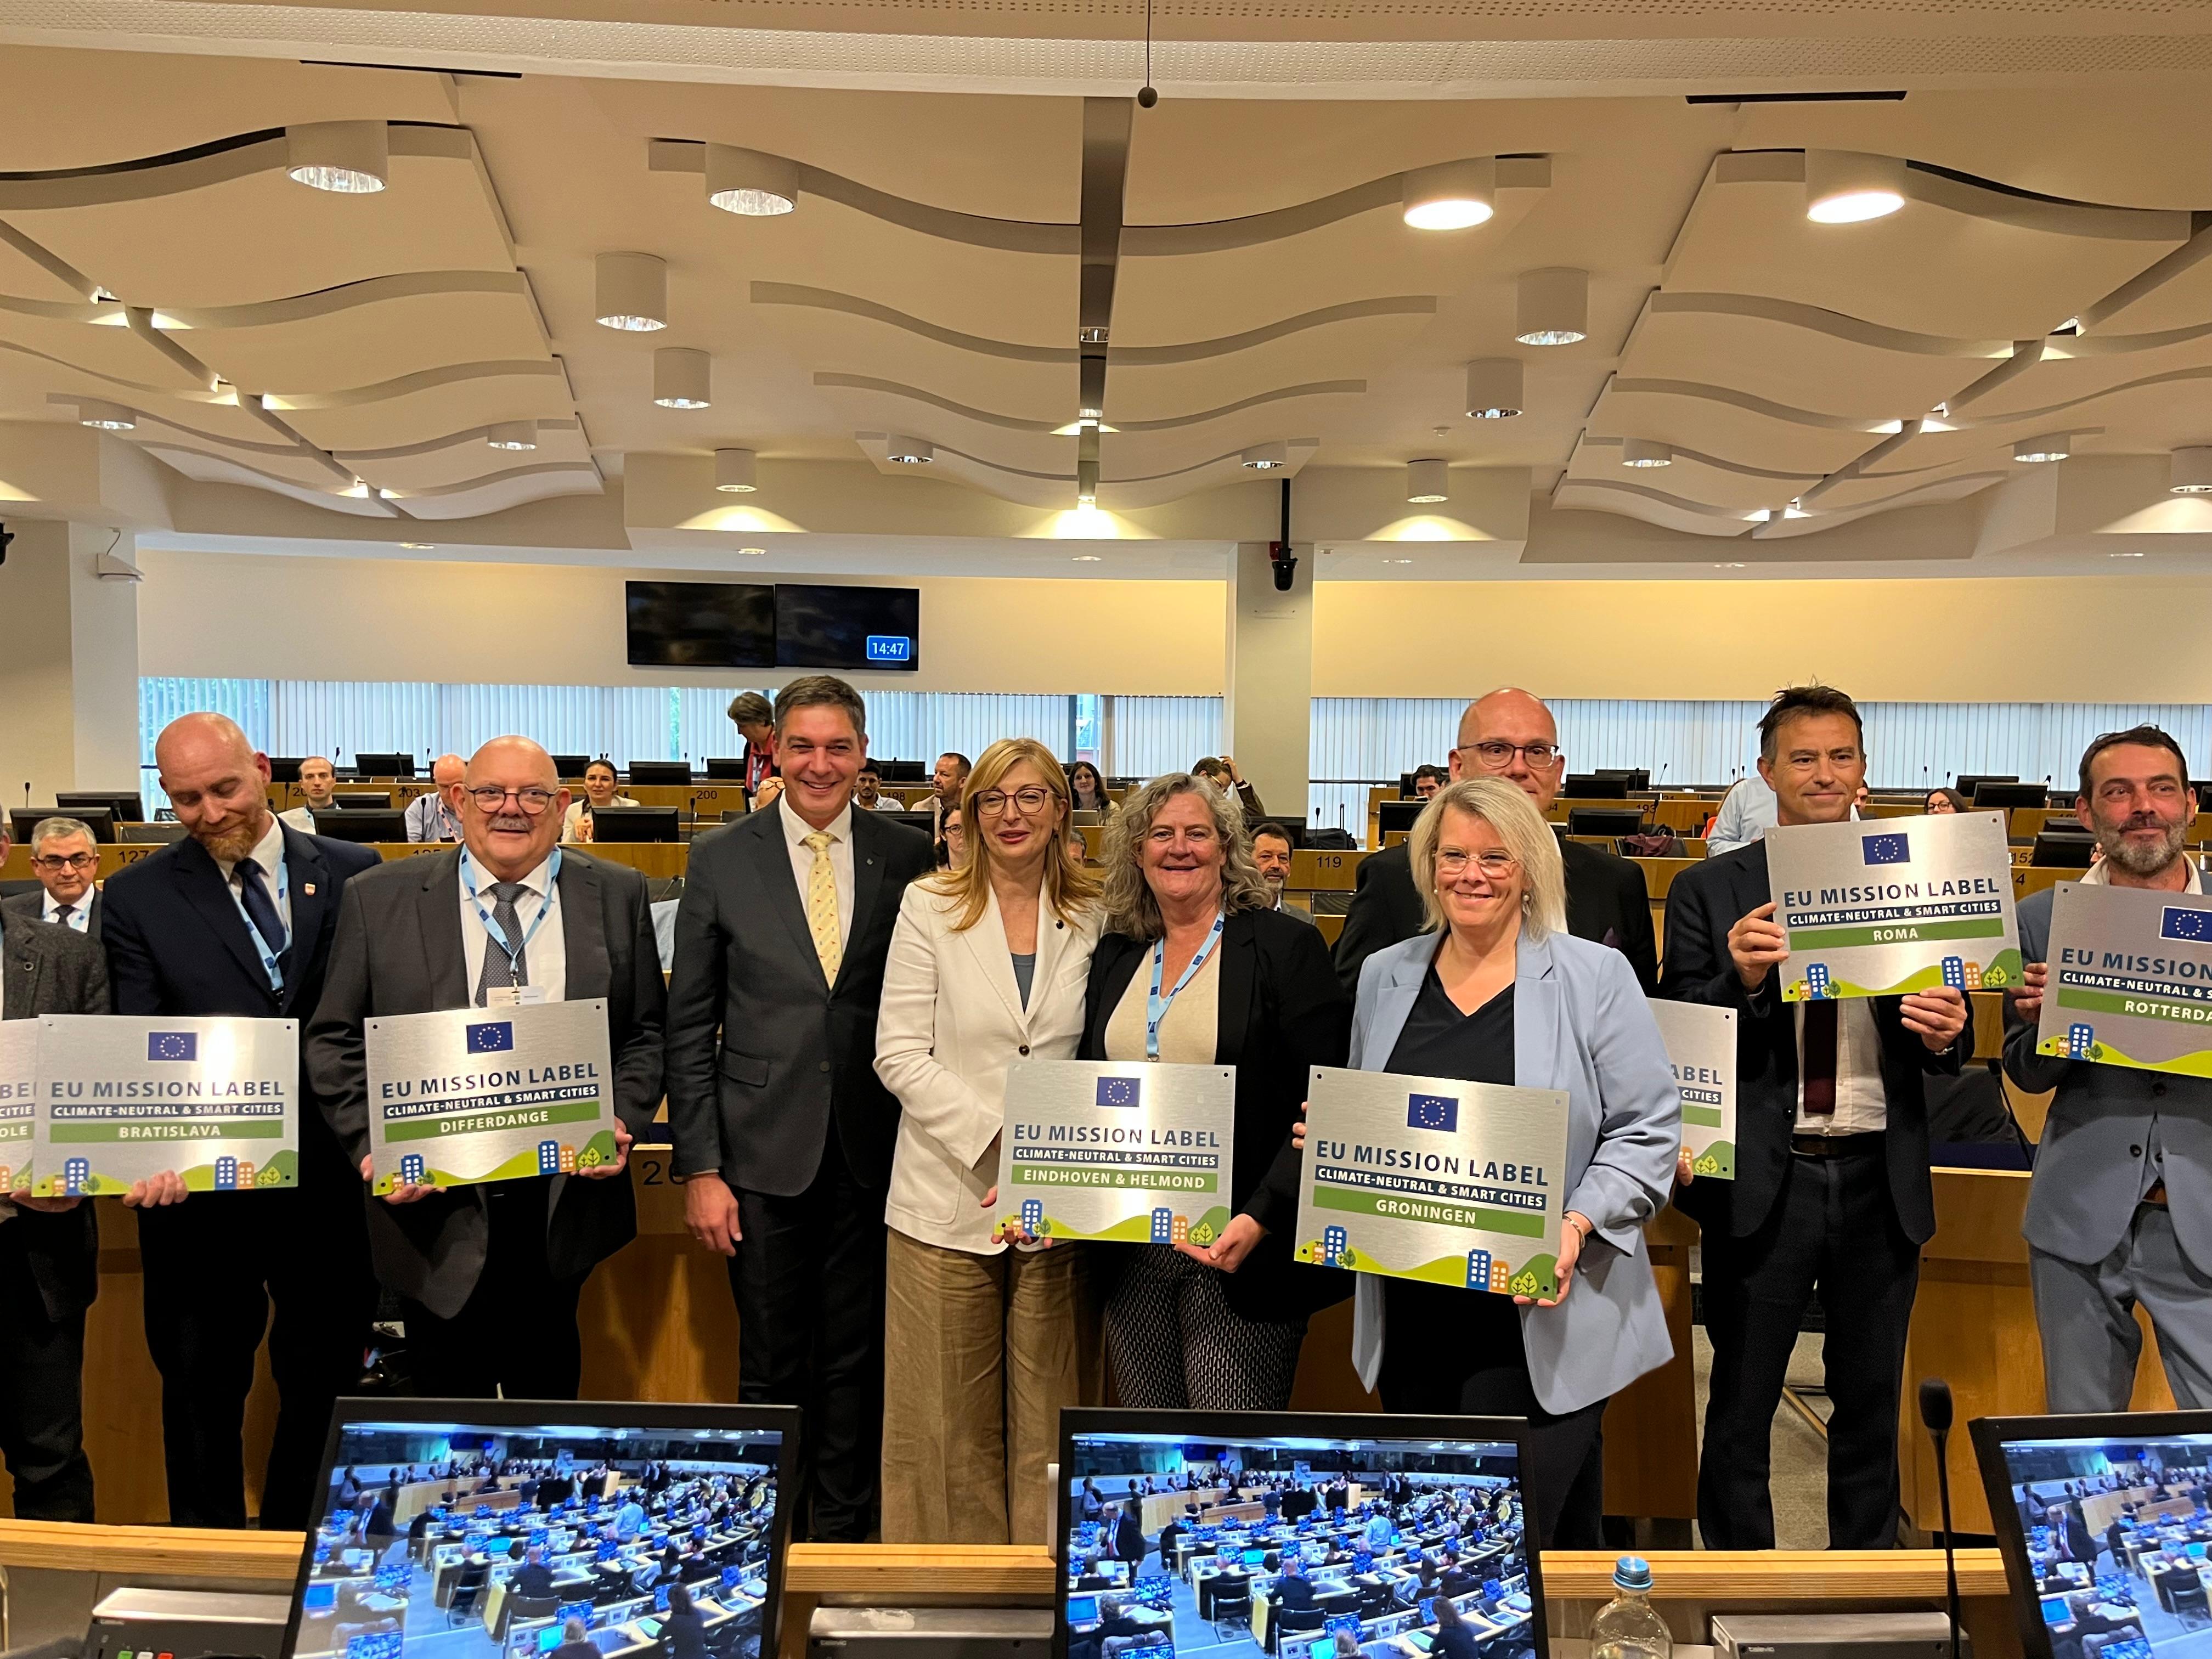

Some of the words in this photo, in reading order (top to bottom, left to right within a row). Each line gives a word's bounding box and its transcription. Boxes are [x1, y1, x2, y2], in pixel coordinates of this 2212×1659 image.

[872, 642, 904, 655] 14:47
[398, 788, 420, 797] 203
[697, 790, 718, 799] 200
[1317, 856, 1342, 868] 119
[1784, 890, 1812, 907] EU
[1821, 884, 1918, 905] MISSION
[1928, 878, 2000, 897] LABEL
[1790, 908, 1900, 925] CLIMATE-NEUTRAL
[1904, 907, 1912, 917] &
[1915, 904, 1955, 916] SMART
[1960, 901, 1998, 913] CITIES
[1874, 928, 1918, 941] ROMA
[2061, 947, 2094, 965] EU
[2103, 952, 2212, 980] MISSION
[2063, 973, 2188, 997] CLIMATE-NEUTRAL
[2193, 989, 2202, 998] &
[52, 1082, 83, 1097] EU
[93, 1082, 201, 1097] MISSION
[212, 1081, 284, 1096] LABEL
[382, 1081, 411, 1098] EU
[421, 1070, 521, 1094] MISSION
[529, 1063, 599, 1084] LABEL
[387, 1097, 500, 1116] CLIMATE-NEUTRAL
[504, 1095, 512, 1104] &
[516, 1090, 556, 1103] SMART
[560, 1086, 596, 1098] CITIES
[1682, 1089, 1719, 1102] CITIES
[0, 1105, 35, 1116] CITIE
[54, 1105, 178, 1116] CLIMATE-NEUTRAL
[182, 1105, 191, 1114] &
[195, 1105, 238, 1115] SMART
[242, 1104, 281, 1114] CITIES
[119, 1125, 221, 1138] BRATISLAVA
[440, 1111, 549, 1133] DIFFERDANGE
[1014, 1124, 1041, 1140] EU
[1048, 1126, 1142, 1144] MISSION
[1152, 1130, 1220, 1147] LABEL
[1016, 1149, 1121, 1162] CLIMATE-NEUTRAL
[1125, 1153, 1132, 1163] &
[1136, 1154, 1174, 1164] SMART
[1179, 1155, 1216, 1166] CITIES
[1317, 1140, 1345, 1160] EU
[1353, 1145, 1459, 1174] MISSION
[1470, 1159, 1548, 1186] LABEL
[1024, 1169, 1110, 1184] EINDHOVEN
[1116, 1173, 1125, 1185] &
[1130, 1174, 1205, 1188] HELMOND
[1318, 1168, 1434, 1193] CLIMATE-NEUTRAL
[1438, 1183, 1447, 1194] &
[1451, 1185, 1496, 1201] SMART
[1500, 1192, 1543, 1207] CITIES
[1376, 1199, 1476, 1224] GRONINGEN
